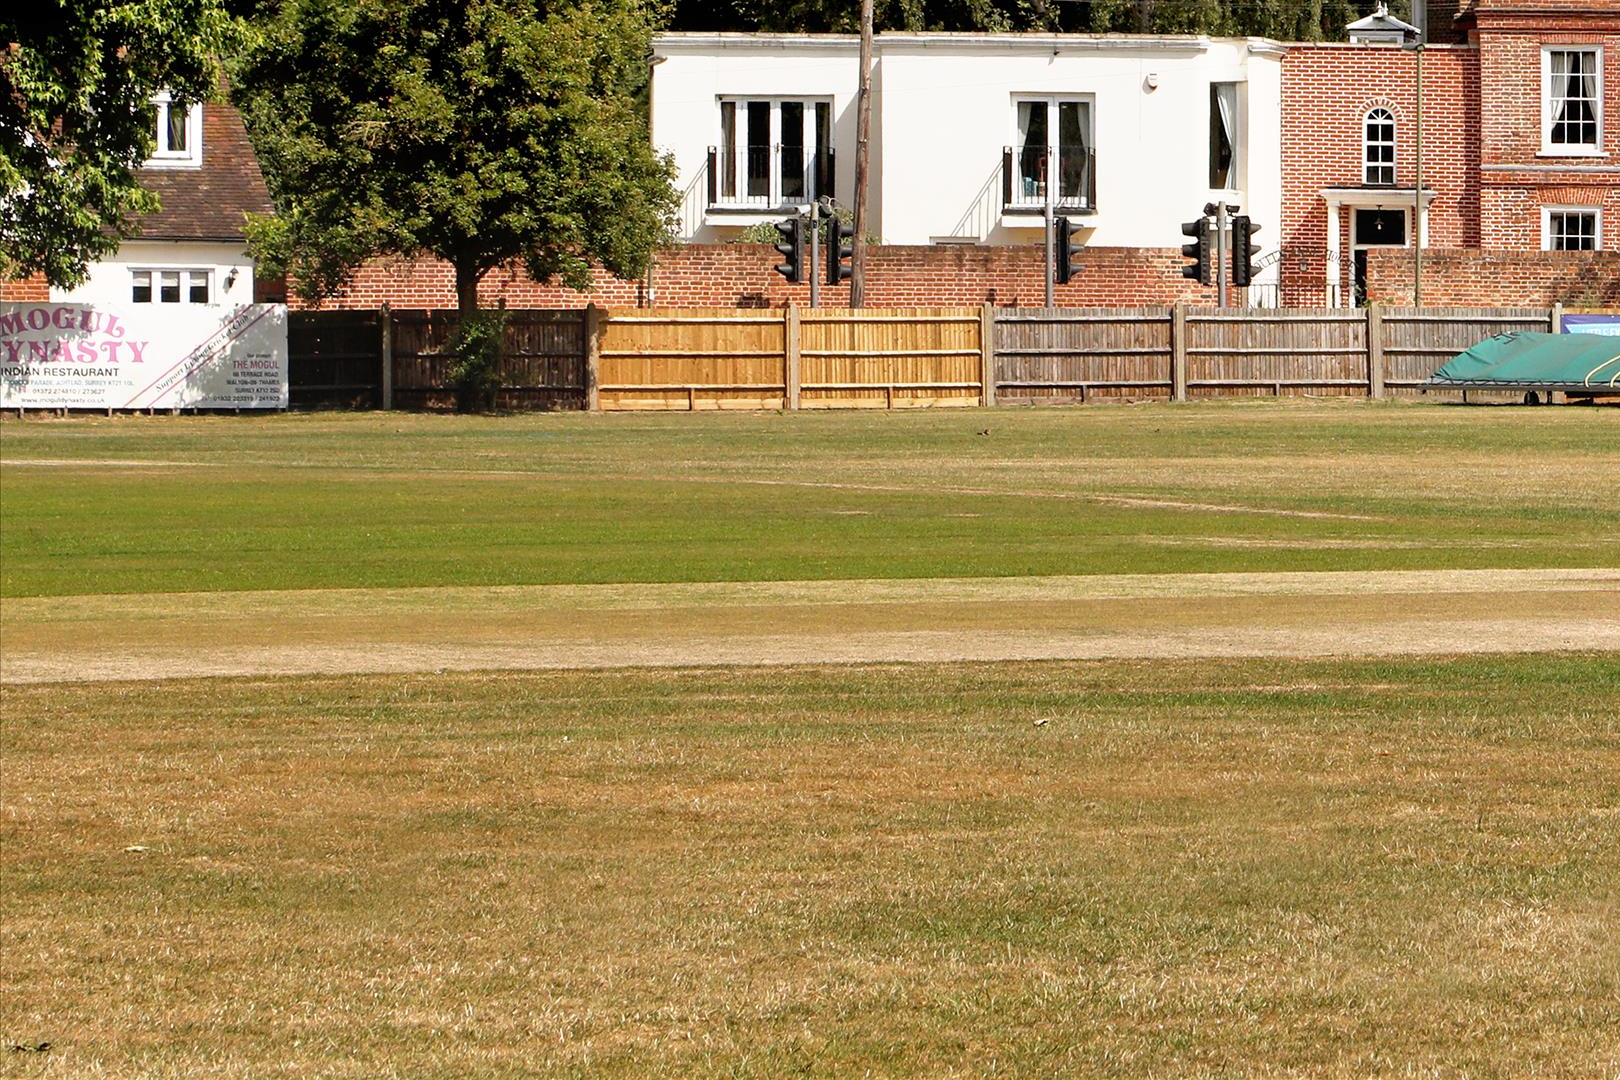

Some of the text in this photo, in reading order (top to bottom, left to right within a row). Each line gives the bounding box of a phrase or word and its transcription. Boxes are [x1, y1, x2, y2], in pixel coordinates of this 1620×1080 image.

[0, 307, 125, 338] MOGUL
[0, 341, 149, 363] YNASTY
[1, 367, 119, 377] INDIAN RESTAURANT
[233, 361, 280, 369] THE MOGUL
